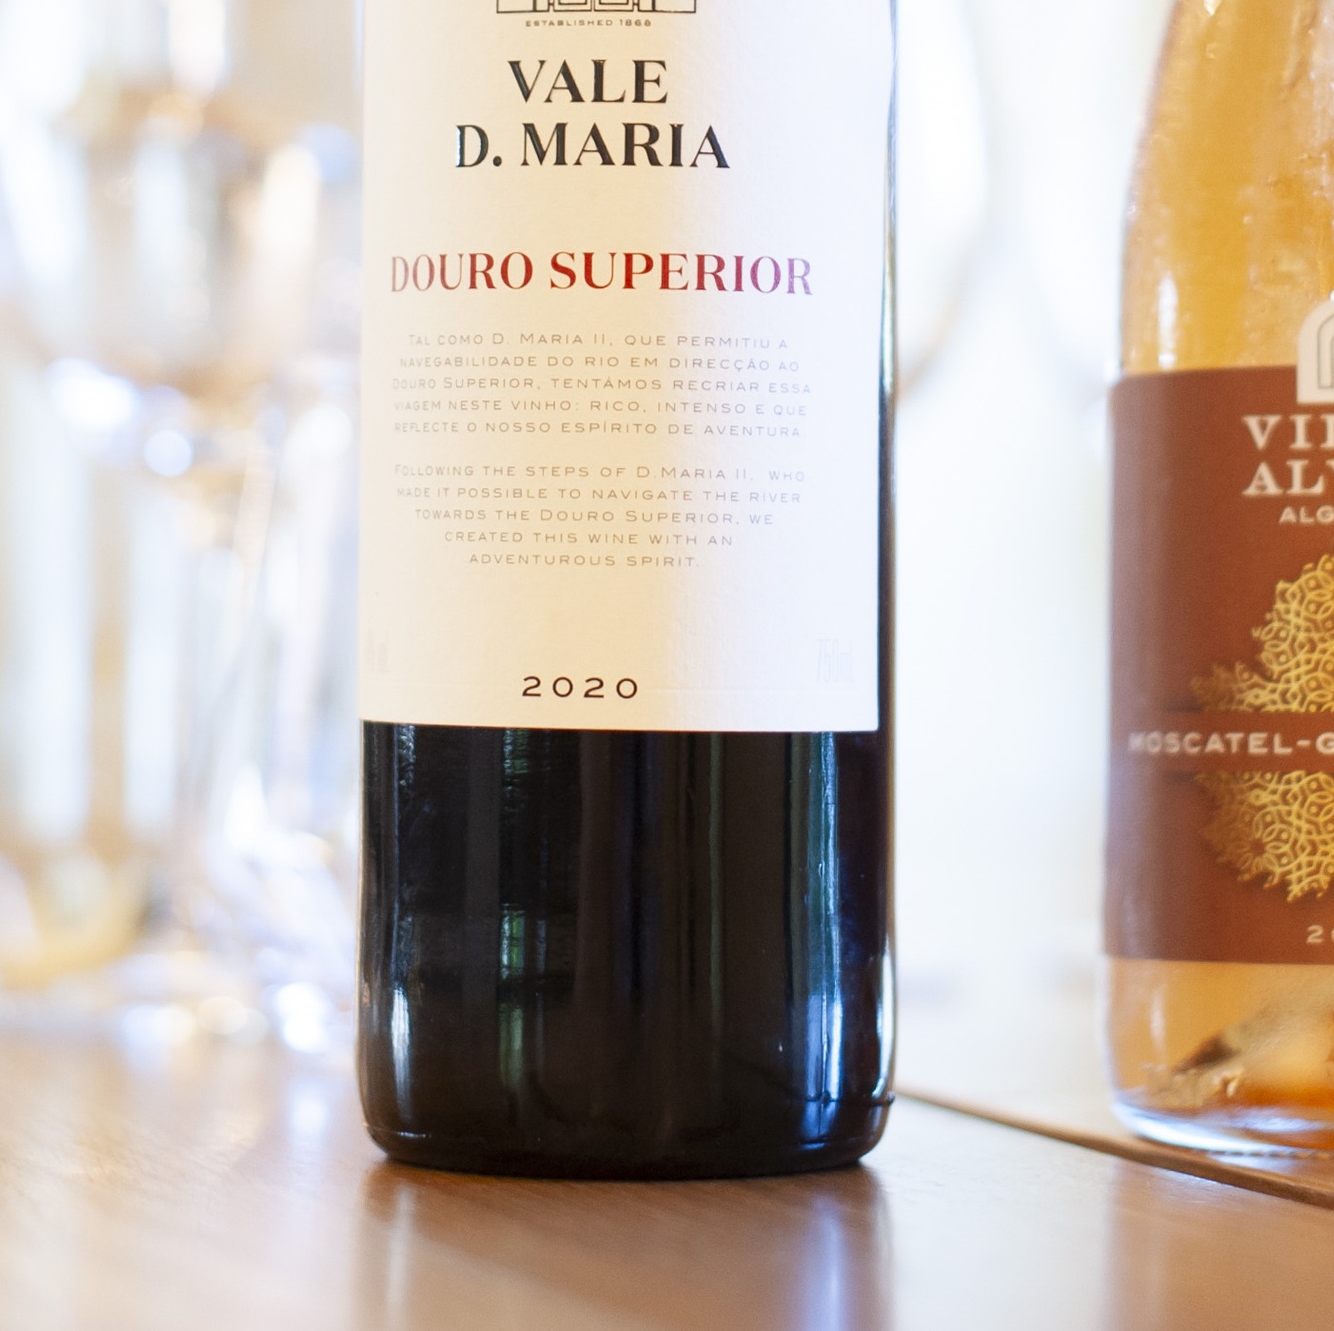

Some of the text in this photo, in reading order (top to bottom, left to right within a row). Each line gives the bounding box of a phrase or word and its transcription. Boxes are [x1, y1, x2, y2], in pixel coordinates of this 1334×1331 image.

[525, 19, 613, 27] ESTABLISHED
[507, 59, 668, 104] VALE
[455, 122, 730, 168] D. MARIA
[390, 251, 813, 295] DOURO SUPERIOR
[408, 333, 431, 347] TAL
[437, 333, 484, 346] COMO
[519, 332, 584, 345] MARIA
[623, 334, 666, 347] QUE
[676, 335, 770, 349] PERMITIU
[778, 338, 788, 350] A
[399, 355, 537, 368] NAVEGABILIDADE
[547, 355, 575, 368] DO
[584, 355, 620, 368] RIO
[630, 356, 658, 368] EM
[778, 360, 800, 373] AO
[392, 377, 437, 391] DOURO
[550, 376, 663, 391] TENTÁMOS
[672, 379, 760, 392] RECRIAR
[768, 382, 811, 395] ESSA
[394, 400, 442, 412] VIAGEM
[448, 399, 502, 411] NESTE
[657, 401, 746, 415] INTENSO
[755, 403, 765, 415] E
[772, 404, 807, 417] QUE
[394, 421, 460, 434] REFLECTE
[466, 421, 478, 433] O
[485, 421, 551, 434] NOSSO
[560, 420, 658, 435] ESPÍRITO
[667, 423, 694, 435] DE
[394, 463, 475, 477] FOLLOWING
[482, 465, 516, 477] THE
[525, 465, 590, 478] STEPS
[599, 466, 626, 478] OF
[768, 470, 805, 483] WHO
[396, 486, 801, 504] MADE IT POSSIBLE TO NAVIGATE THE RIVER
[414, 508, 487, 521] TOWARDS
[495, 509, 530, 522] THE
[539, 508, 615, 523] DOURO
[748, 513, 774, 526] WE
[444, 530, 733, 546] CREATED THIS WINE WITH AN
[468, 553, 701, 568] ADVENTUROUS SPIRIT.
[522, 676, 638, 699] 2020
